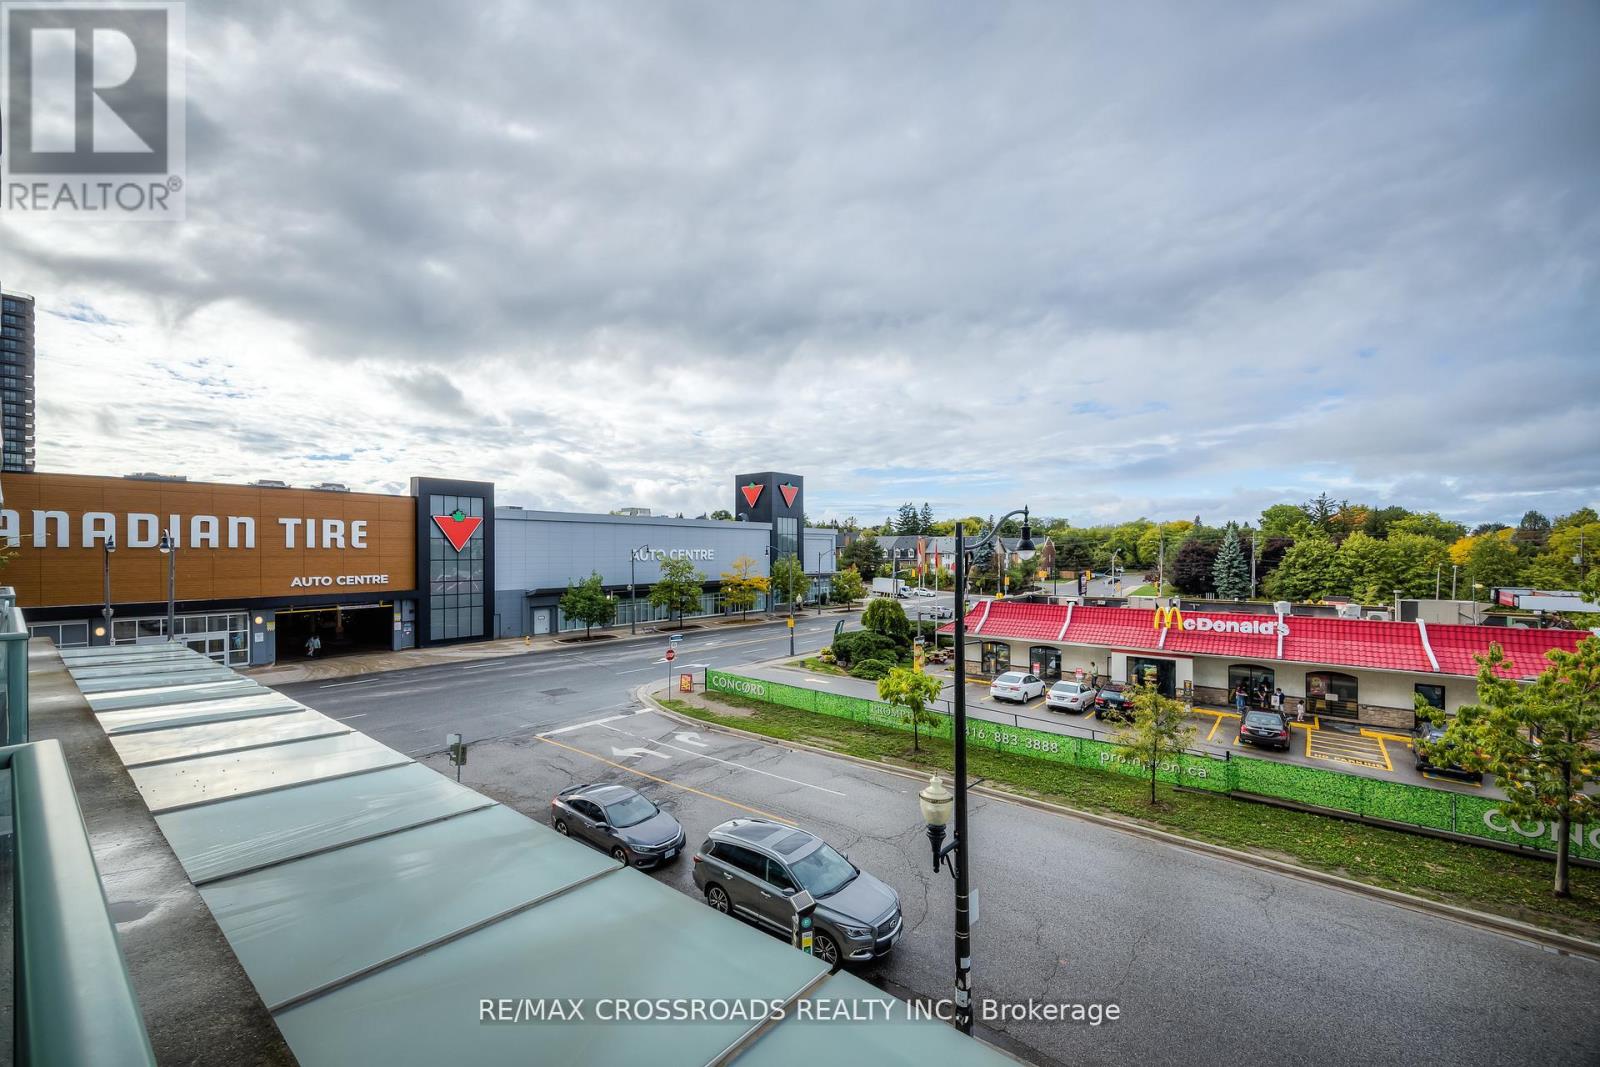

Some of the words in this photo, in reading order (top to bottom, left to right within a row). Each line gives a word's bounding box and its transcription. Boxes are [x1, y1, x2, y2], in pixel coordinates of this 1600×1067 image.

[278, 517, 367, 549] TIRE
[630, 548, 666, 561] AUTO
[669, 549, 715, 560] CENTRE
[291, 576, 332, 587] AUTO
[336, 574, 389, 586] CENTRE
[1154, 606, 1290, 636] McDonald's
[712, 675, 765, 696] CONCORD
[994, 731, 1018, 746] 883
[1025, 737, 1058, 753] 3888
